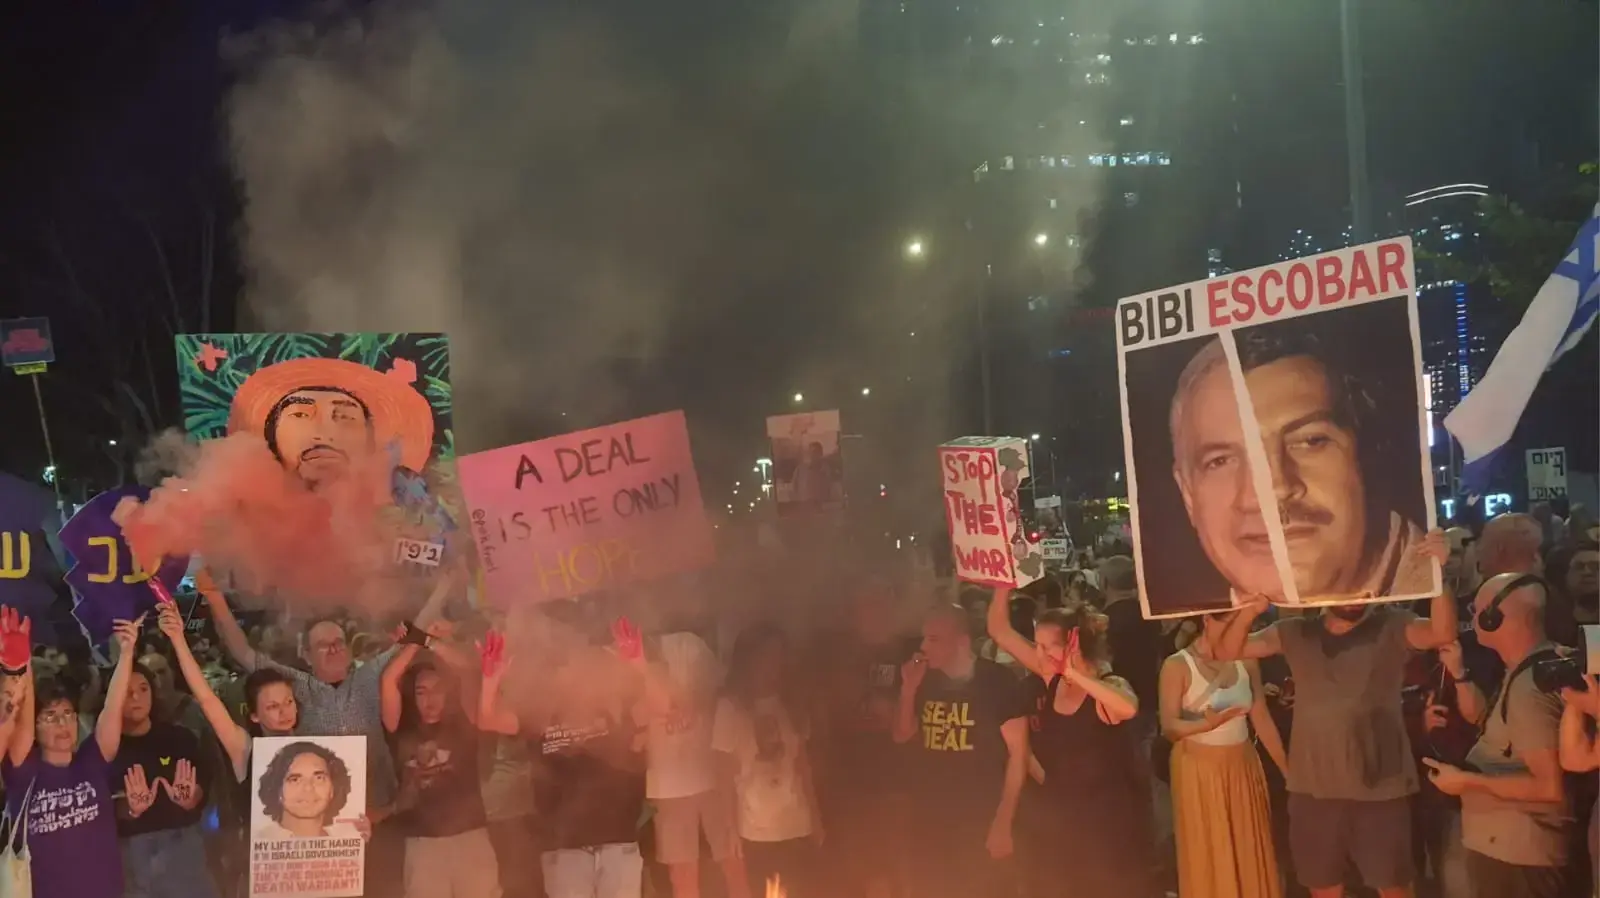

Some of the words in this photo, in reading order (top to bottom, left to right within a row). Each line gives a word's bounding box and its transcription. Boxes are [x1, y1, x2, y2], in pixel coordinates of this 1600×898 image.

[1120, 288, 1195, 346] BIBI
[1206, 243, 1408, 328] ESCOBAR
[515, 454, 543, 490] A
[554, 432, 652, 483] DEAL
[945, 453, 993, 503] STOP
[498, 511, 532, 544] IS
[541, 496, 601, 533] THE
[613, 473, 680, 519] ONLY
[947, 490, 1000, 535] THE
[955, 544, 1009, 578] WAR
[922, 701, 975, 726] SEAL
[254, 841, 269, 851] MY
[271, 840, 293, 850] LIFE
[308, 839, 327, 849] THE
[329, 838, 361, 848] HANDS
[271, 850, 304, 860] ISRAELI
[305, 849, 361, 859] GOVERNMENT
[254, 881, 294, 894] DEATH
